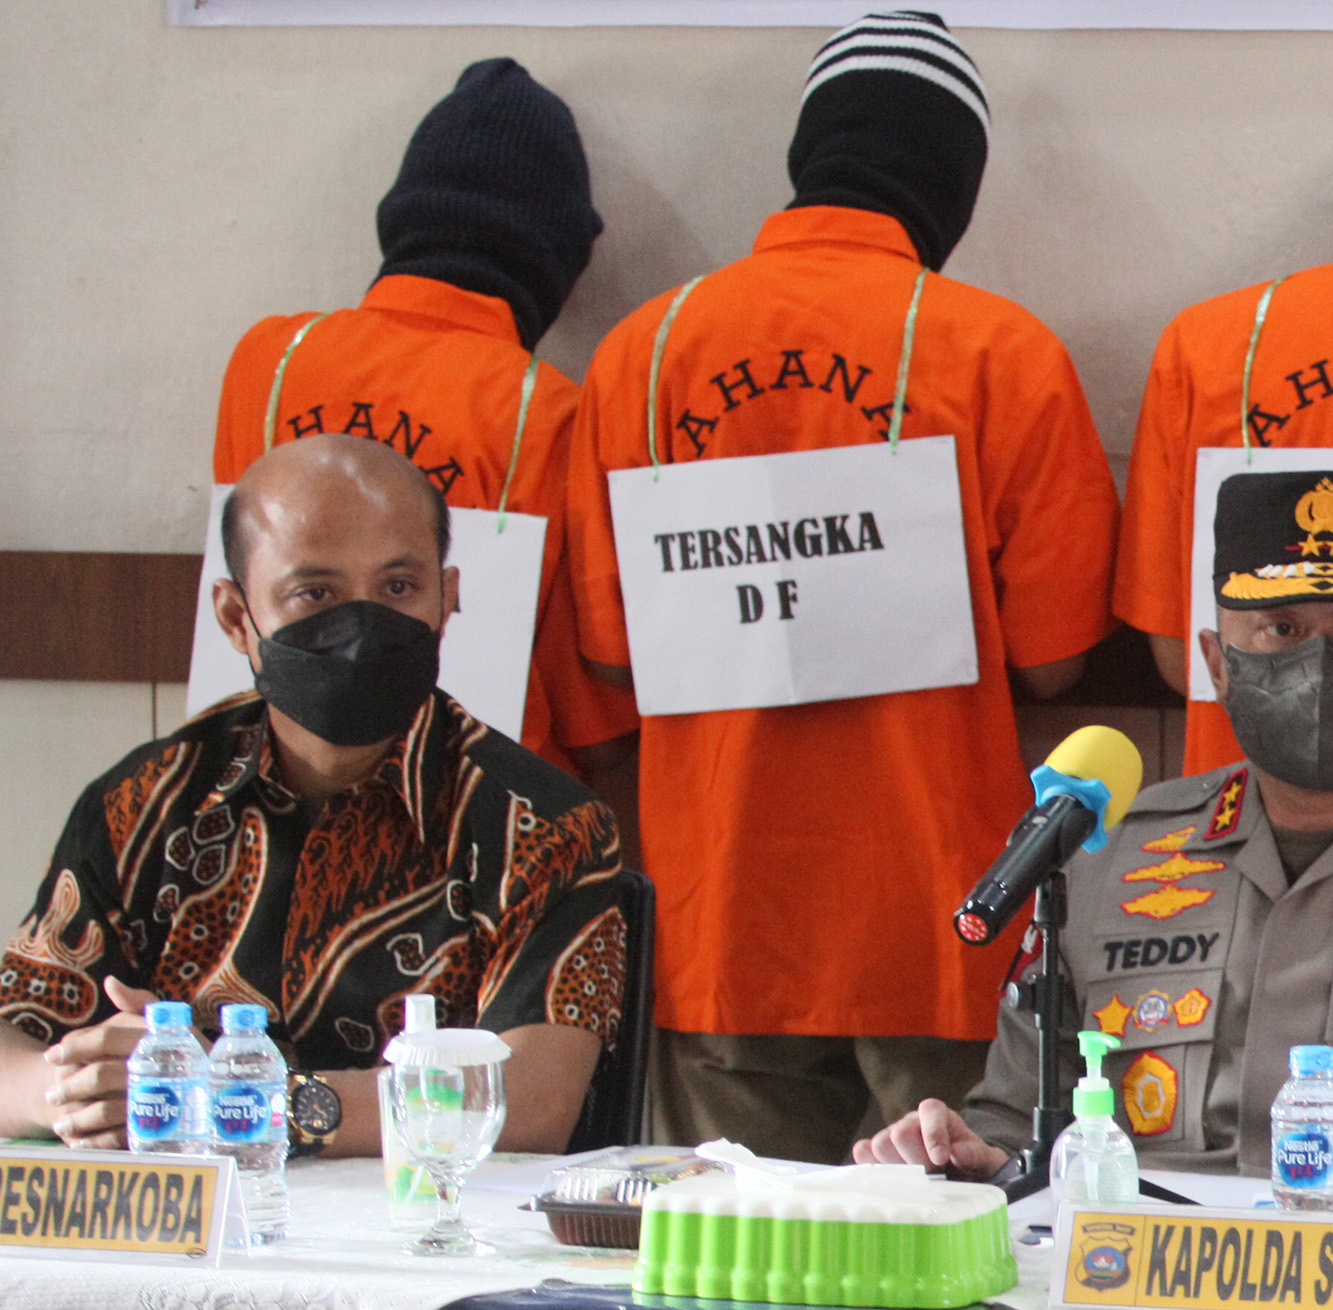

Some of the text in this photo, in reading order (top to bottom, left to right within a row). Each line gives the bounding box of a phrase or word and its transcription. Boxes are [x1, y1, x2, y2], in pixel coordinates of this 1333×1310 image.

[654, 511, 885, 573] TERSANGKA
[736, 579, 798, 624] D F
[1104, 932, 1220, 972] TEDDY
[130, 1101, 180, 1122] Pure Life
[214, 1105, 267, 1124] Pure Life
[1277, 1150, 1333, 1170] Pure Life
[0, 1165, 204, 1244] ESNARKOBA
[1146, 1225, 1303, 1304] KAPOLDA
